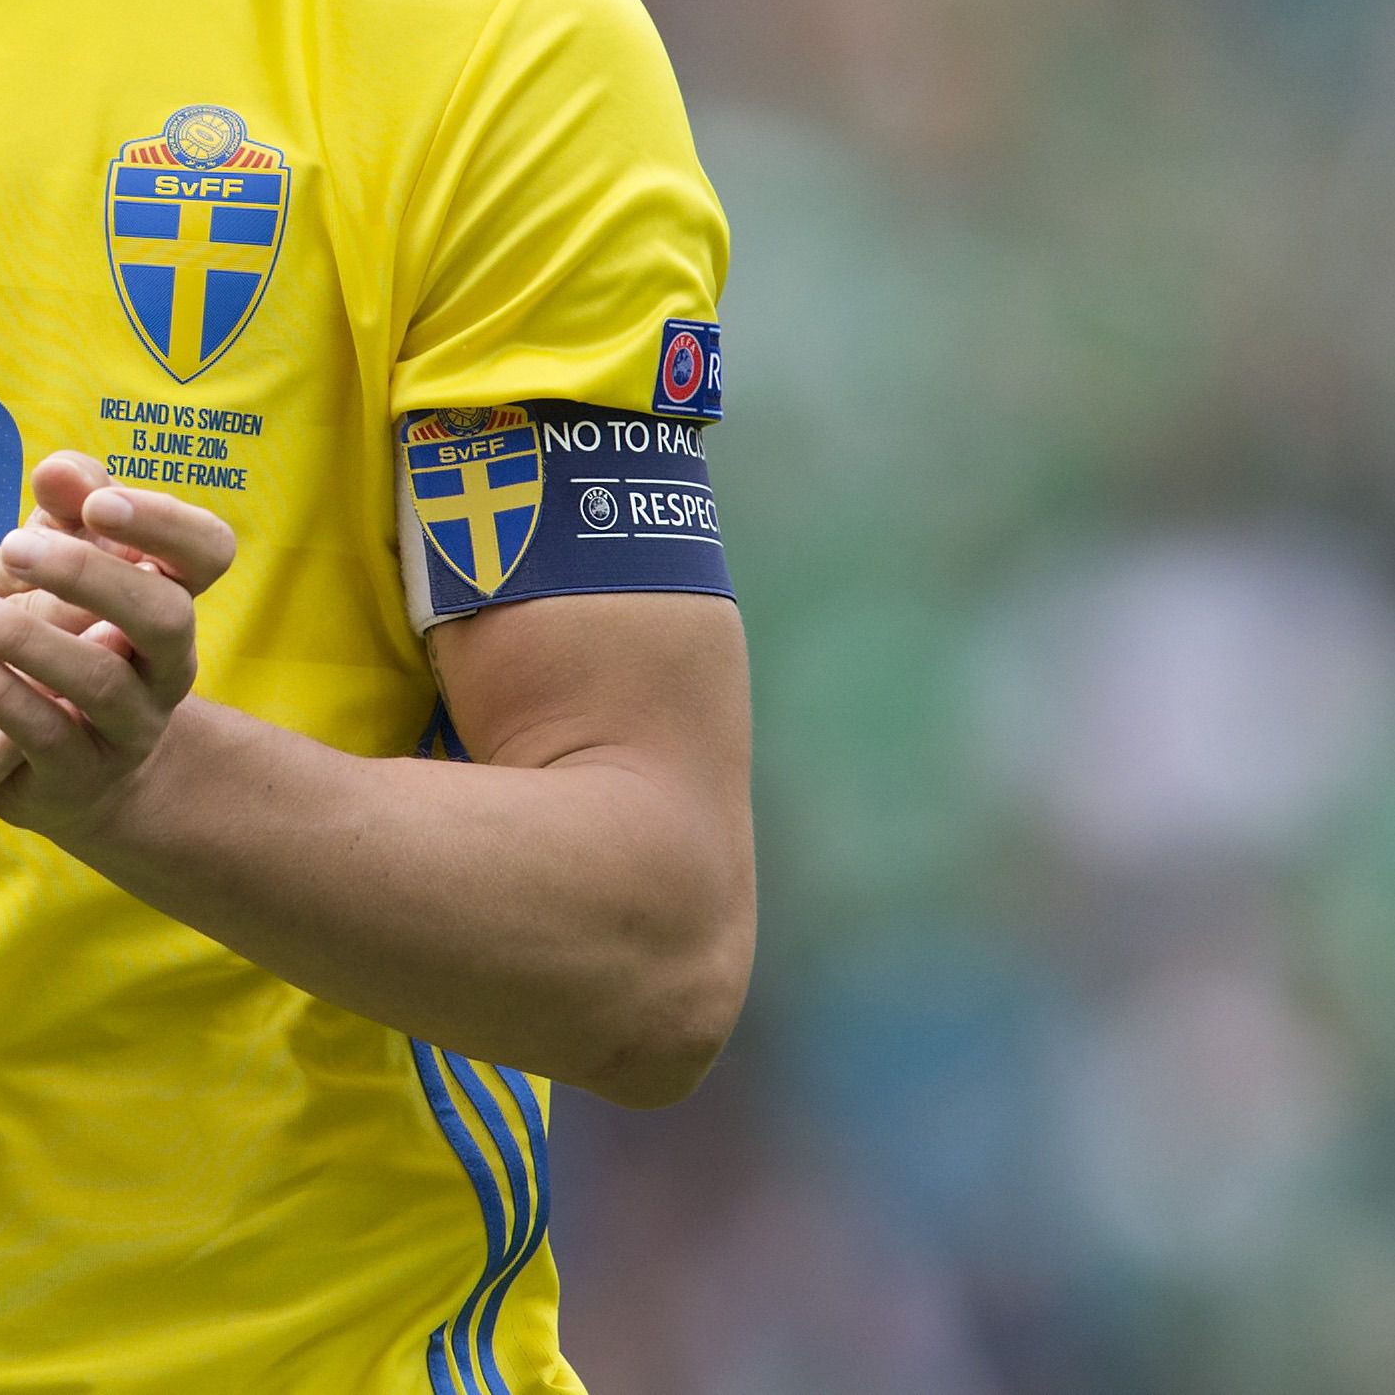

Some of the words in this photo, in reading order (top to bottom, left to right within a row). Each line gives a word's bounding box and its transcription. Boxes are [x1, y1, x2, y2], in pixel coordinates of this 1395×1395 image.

[155, 175, 244, 198] SvFF
[101, 398, 169, 425] IRELAND
[174, 405, 194, 428] VS
[198, 408, 263, 436] SWEDEN
[133, 429, 147, 451] 13
[150, 432, 194, 456] JUNE
[197, 437, 228, 460] 2016
[439, 437, 505, 463] SvFF
[544, 421, 601, 453] NO
[608, 421, 649, 452] TO
[107, 455, 159, 480] STADE
[162, 460, 184, 483] DE
[187, 464, 247, 490] FRANCE
[629, 492, 721, 534] RESPEC
